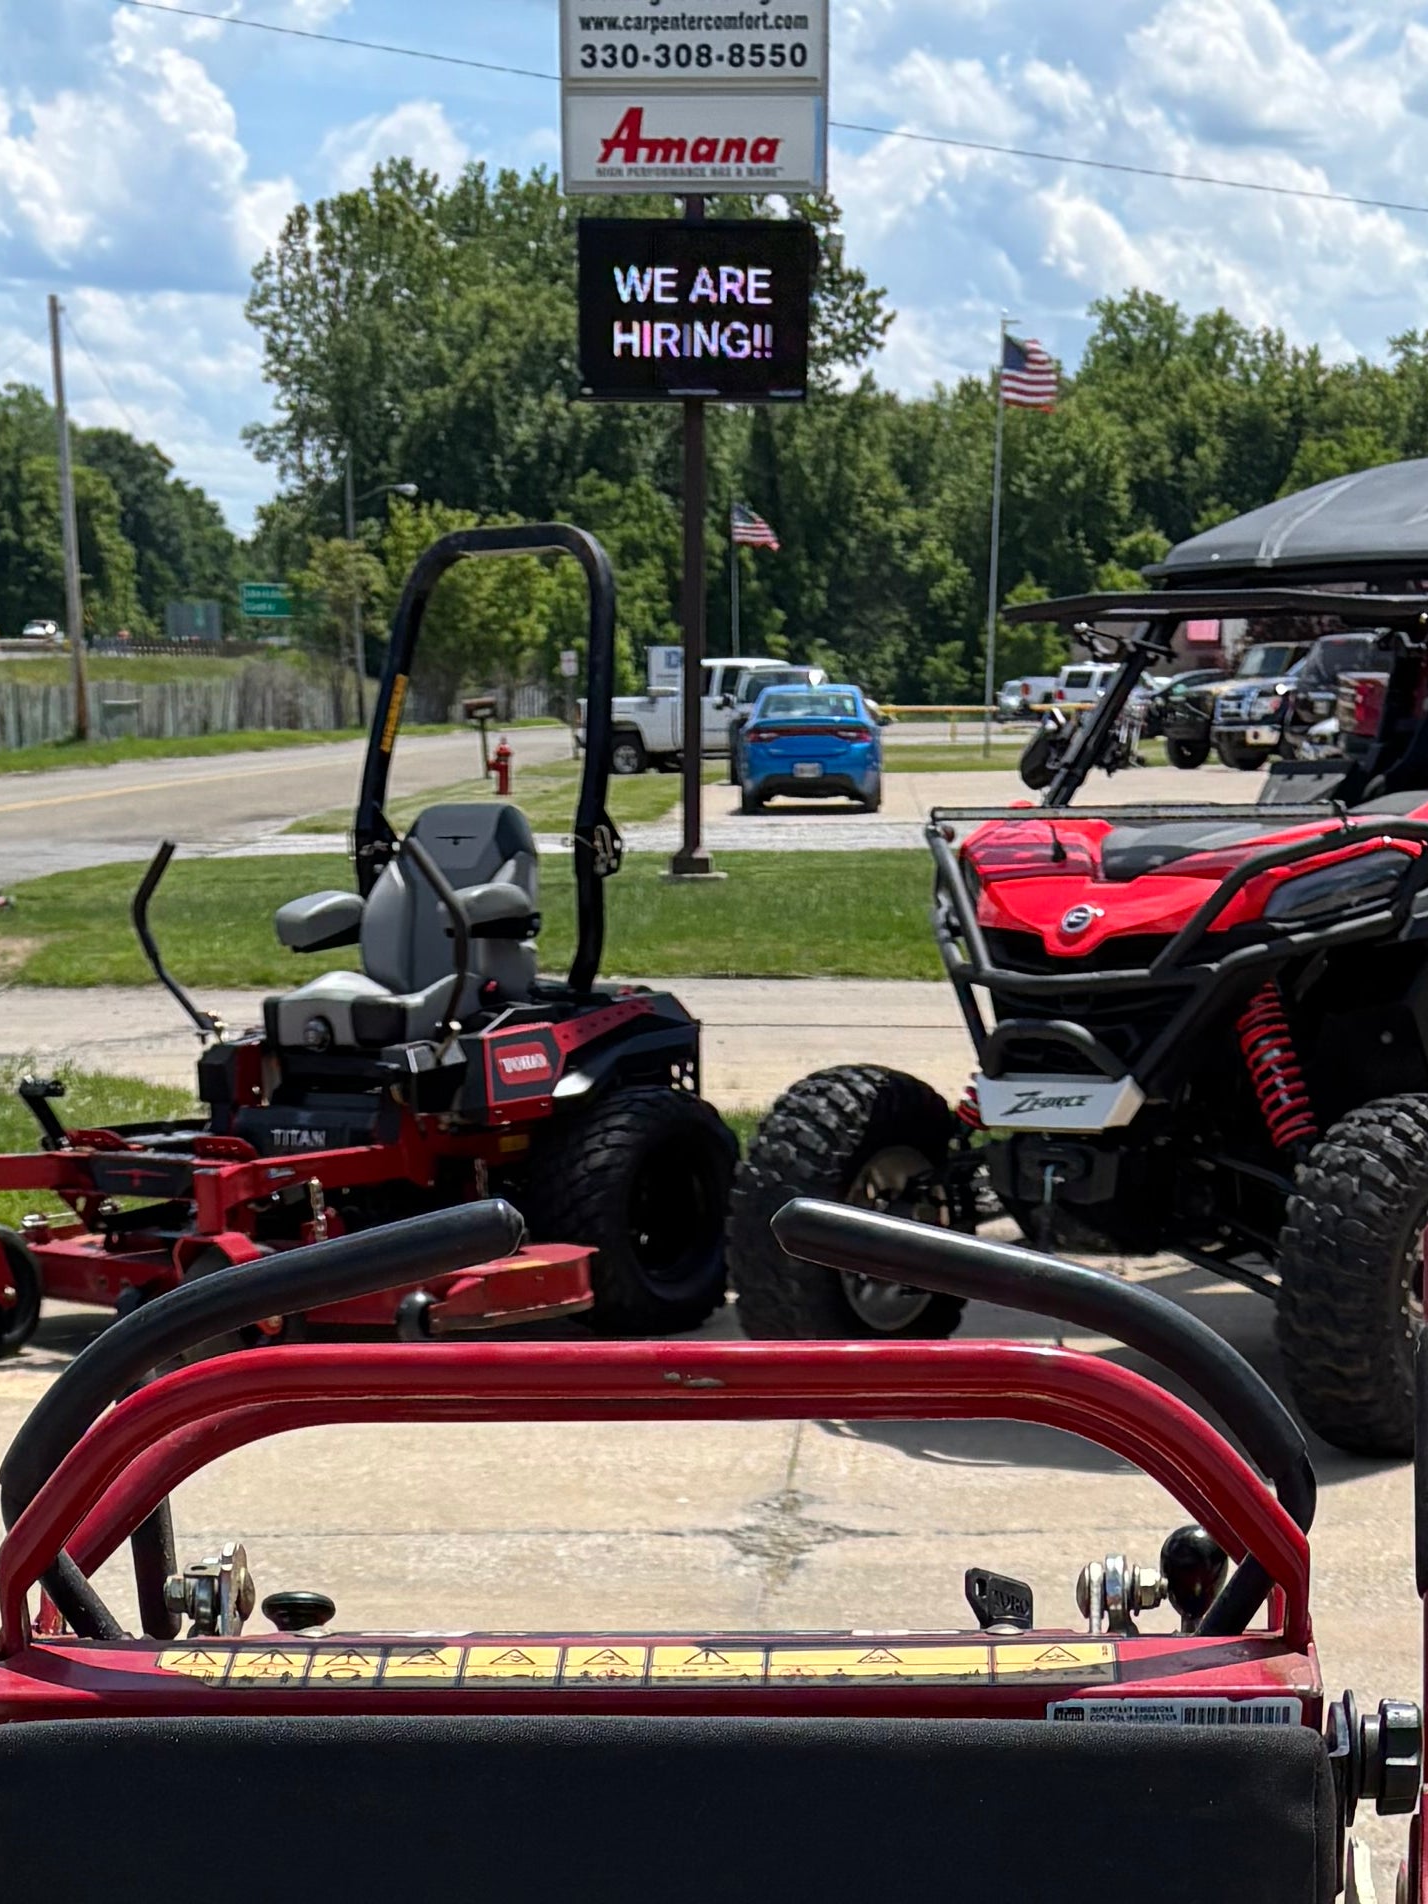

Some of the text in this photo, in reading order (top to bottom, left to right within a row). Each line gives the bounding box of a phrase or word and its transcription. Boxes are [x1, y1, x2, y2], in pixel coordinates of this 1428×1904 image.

[579, 12, 809, 34] www.carpentercomfort.com
[596, 106, 782, 164] Amana
[613, 266, 772, 304] WE ARE
[613, 321, 772, 358] HIRING!!
[271, 1129, 326, 1147] TITAN
